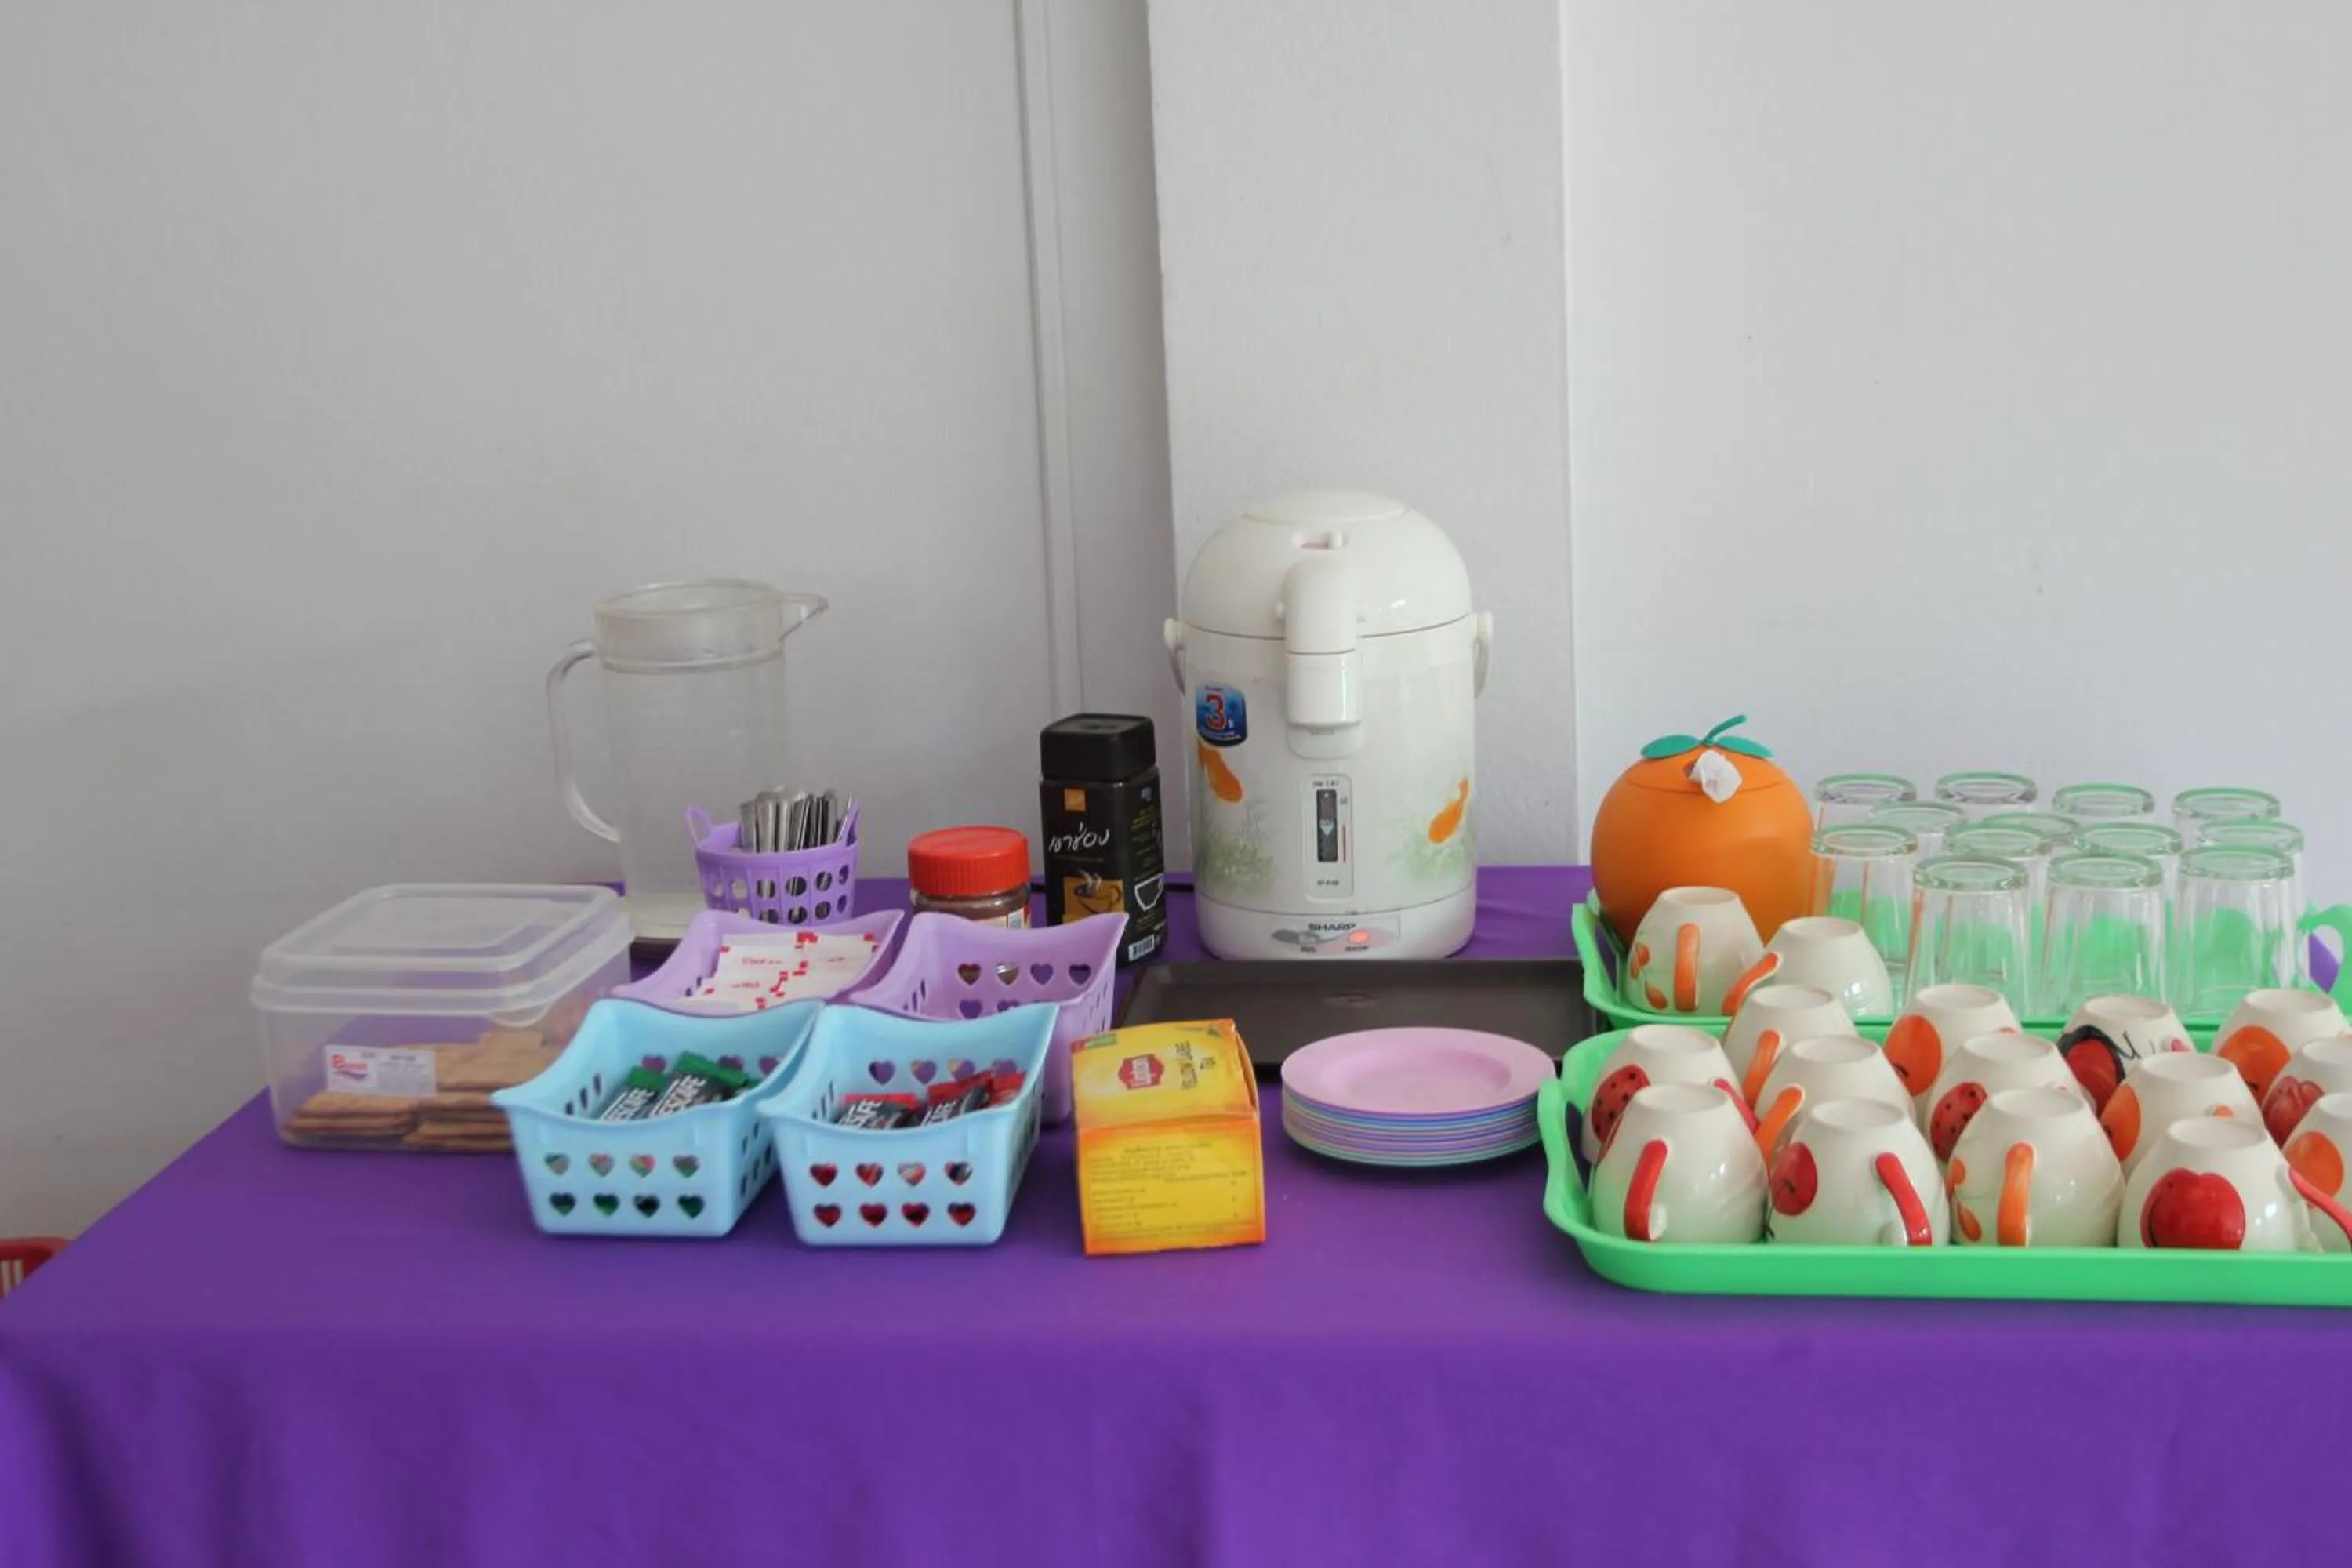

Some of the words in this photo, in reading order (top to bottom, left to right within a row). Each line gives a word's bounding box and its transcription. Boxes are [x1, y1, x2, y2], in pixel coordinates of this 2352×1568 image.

[1205, 693, 1226, 728] 3
[1048, 821, 1110, 853] เขาช่อง
[1308, 923, 1356, 931] SHARP
